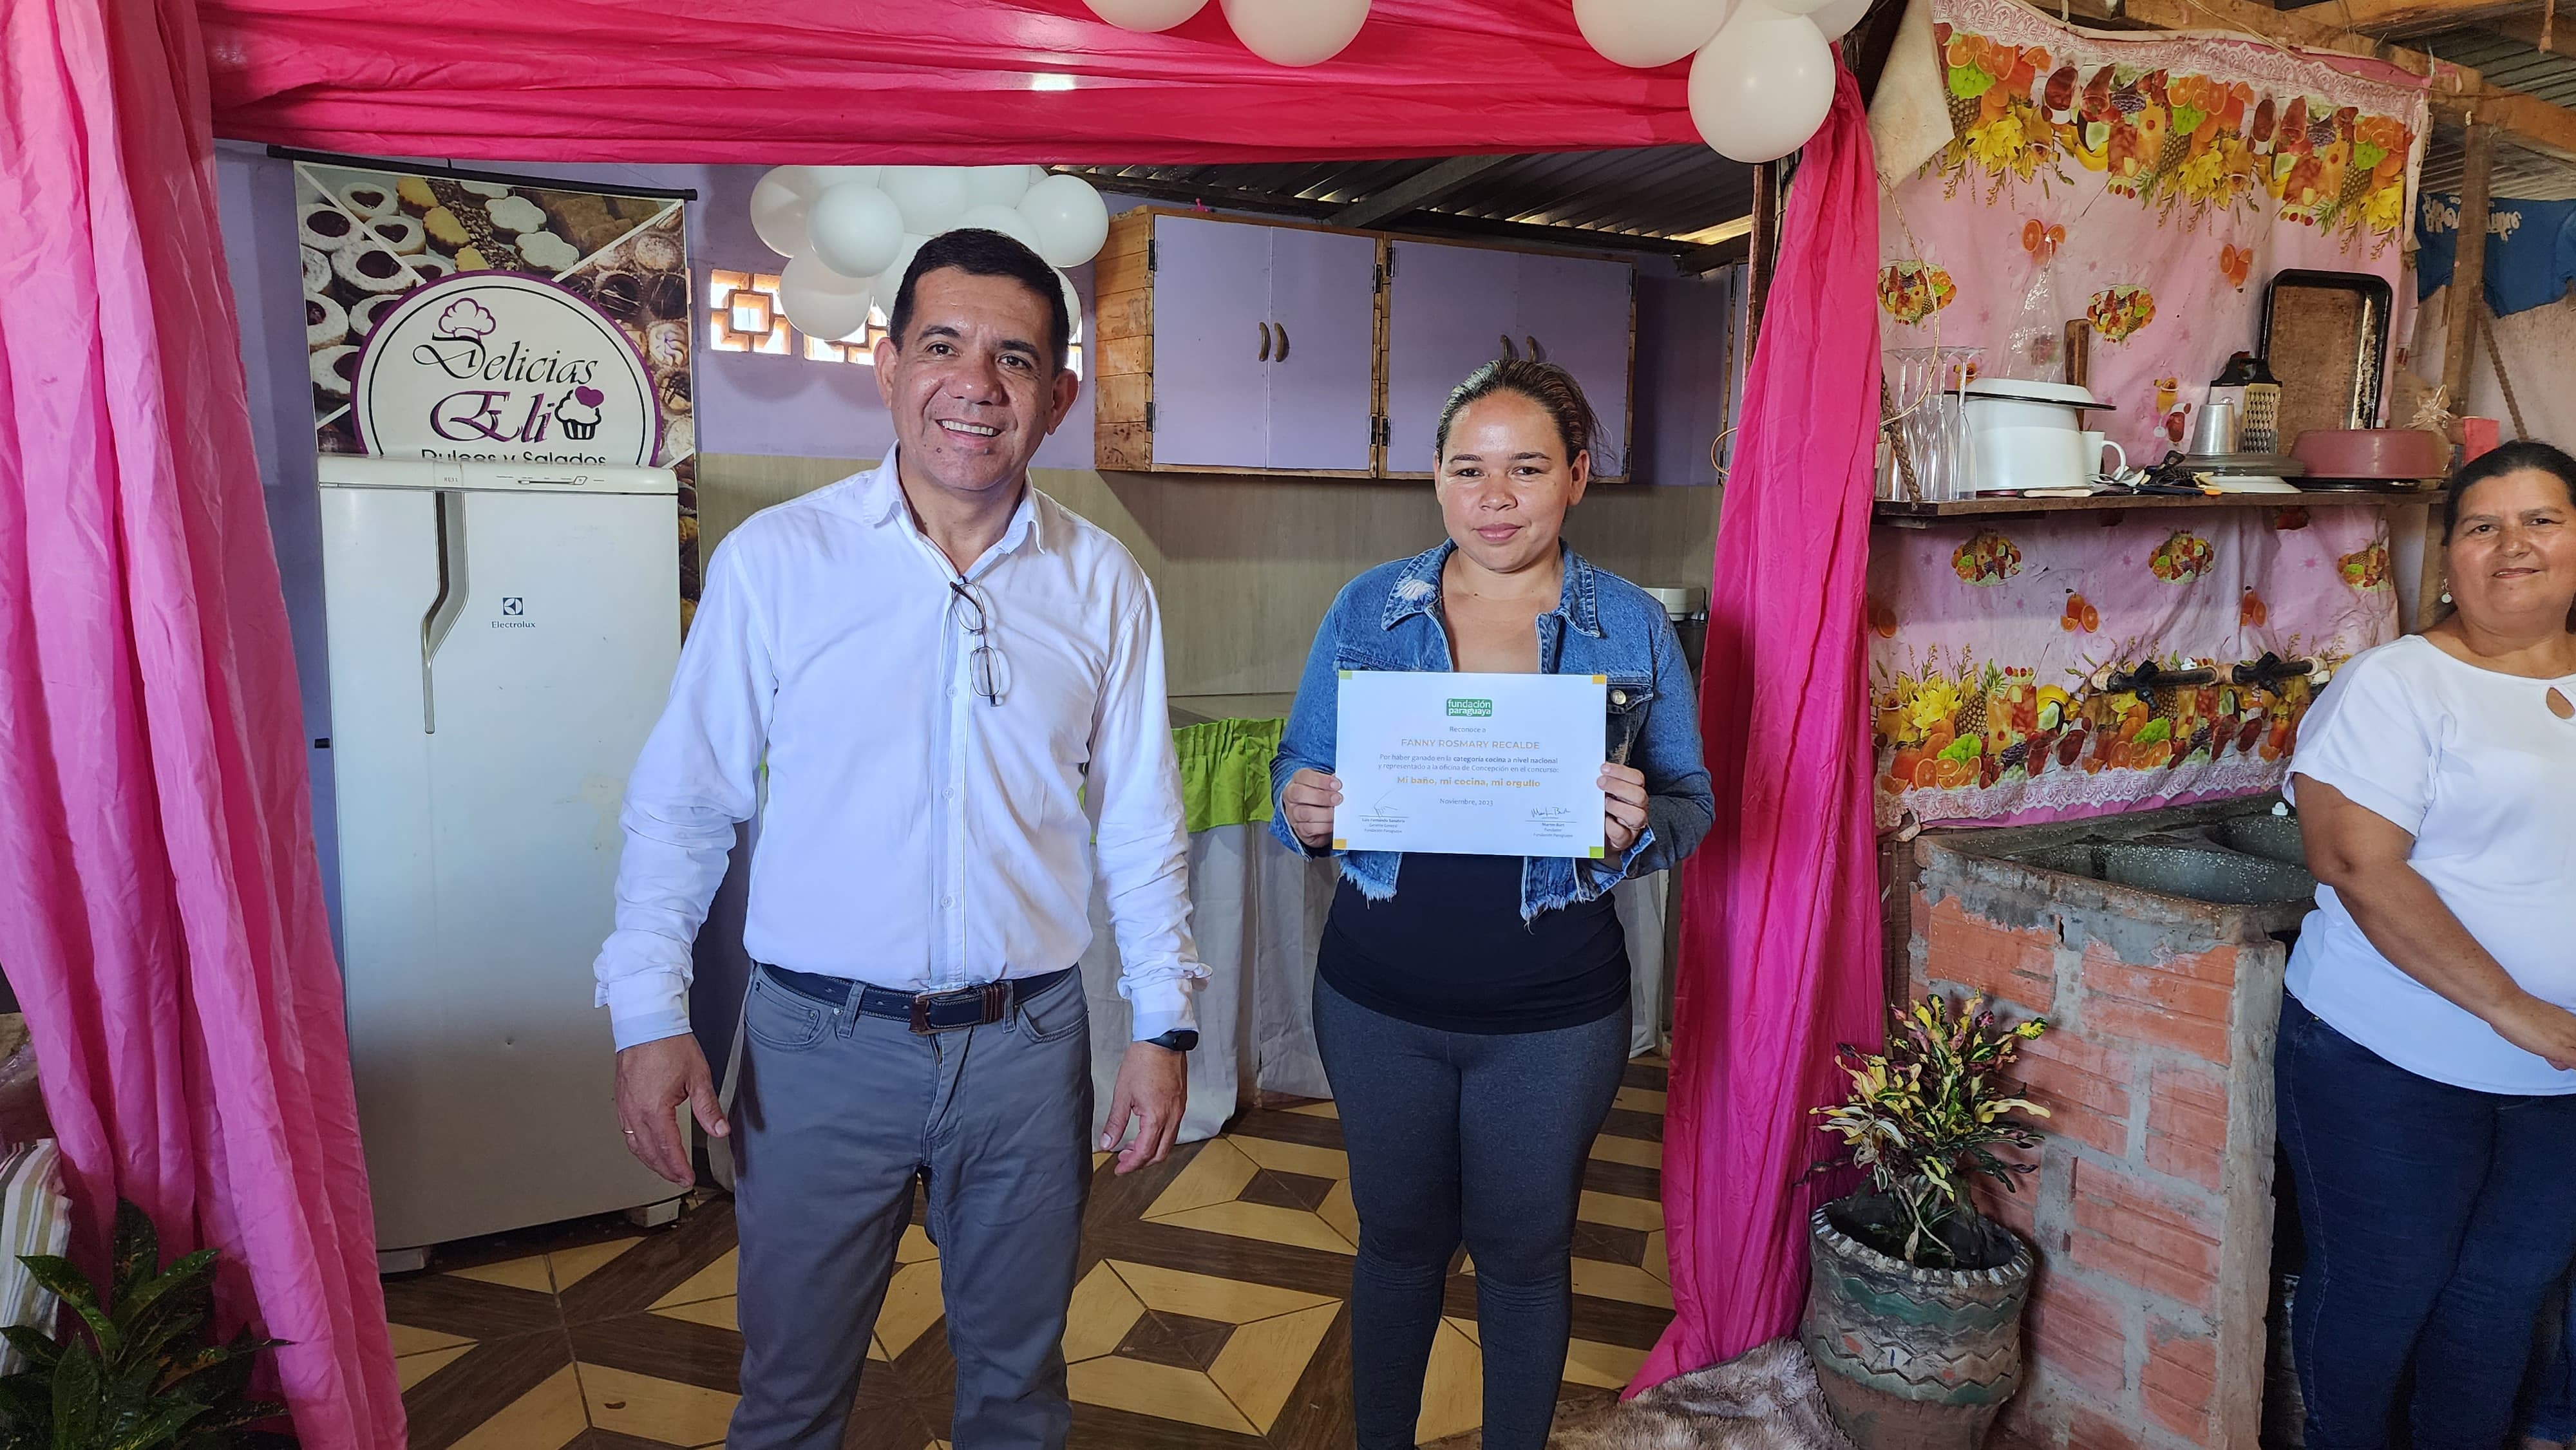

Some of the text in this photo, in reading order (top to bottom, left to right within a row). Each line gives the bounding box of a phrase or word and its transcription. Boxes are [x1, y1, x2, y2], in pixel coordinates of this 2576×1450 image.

[412, 332, 598, 384] Delicias
[430, 390, 555, 443] Eli
[491, 620, 536, 628] Electrolux
[1447, 699, 1491, 708] fundación
[1448, 708, 1491, 716] paraguaya
[1401, 739, 1540, 749] FANNY ROSMARY RECALDE
[1397, 775, 1540, 788] Mi baño, mi cocina, mi orgullo
[1439, 798, 1477, 806] Noviembre,
